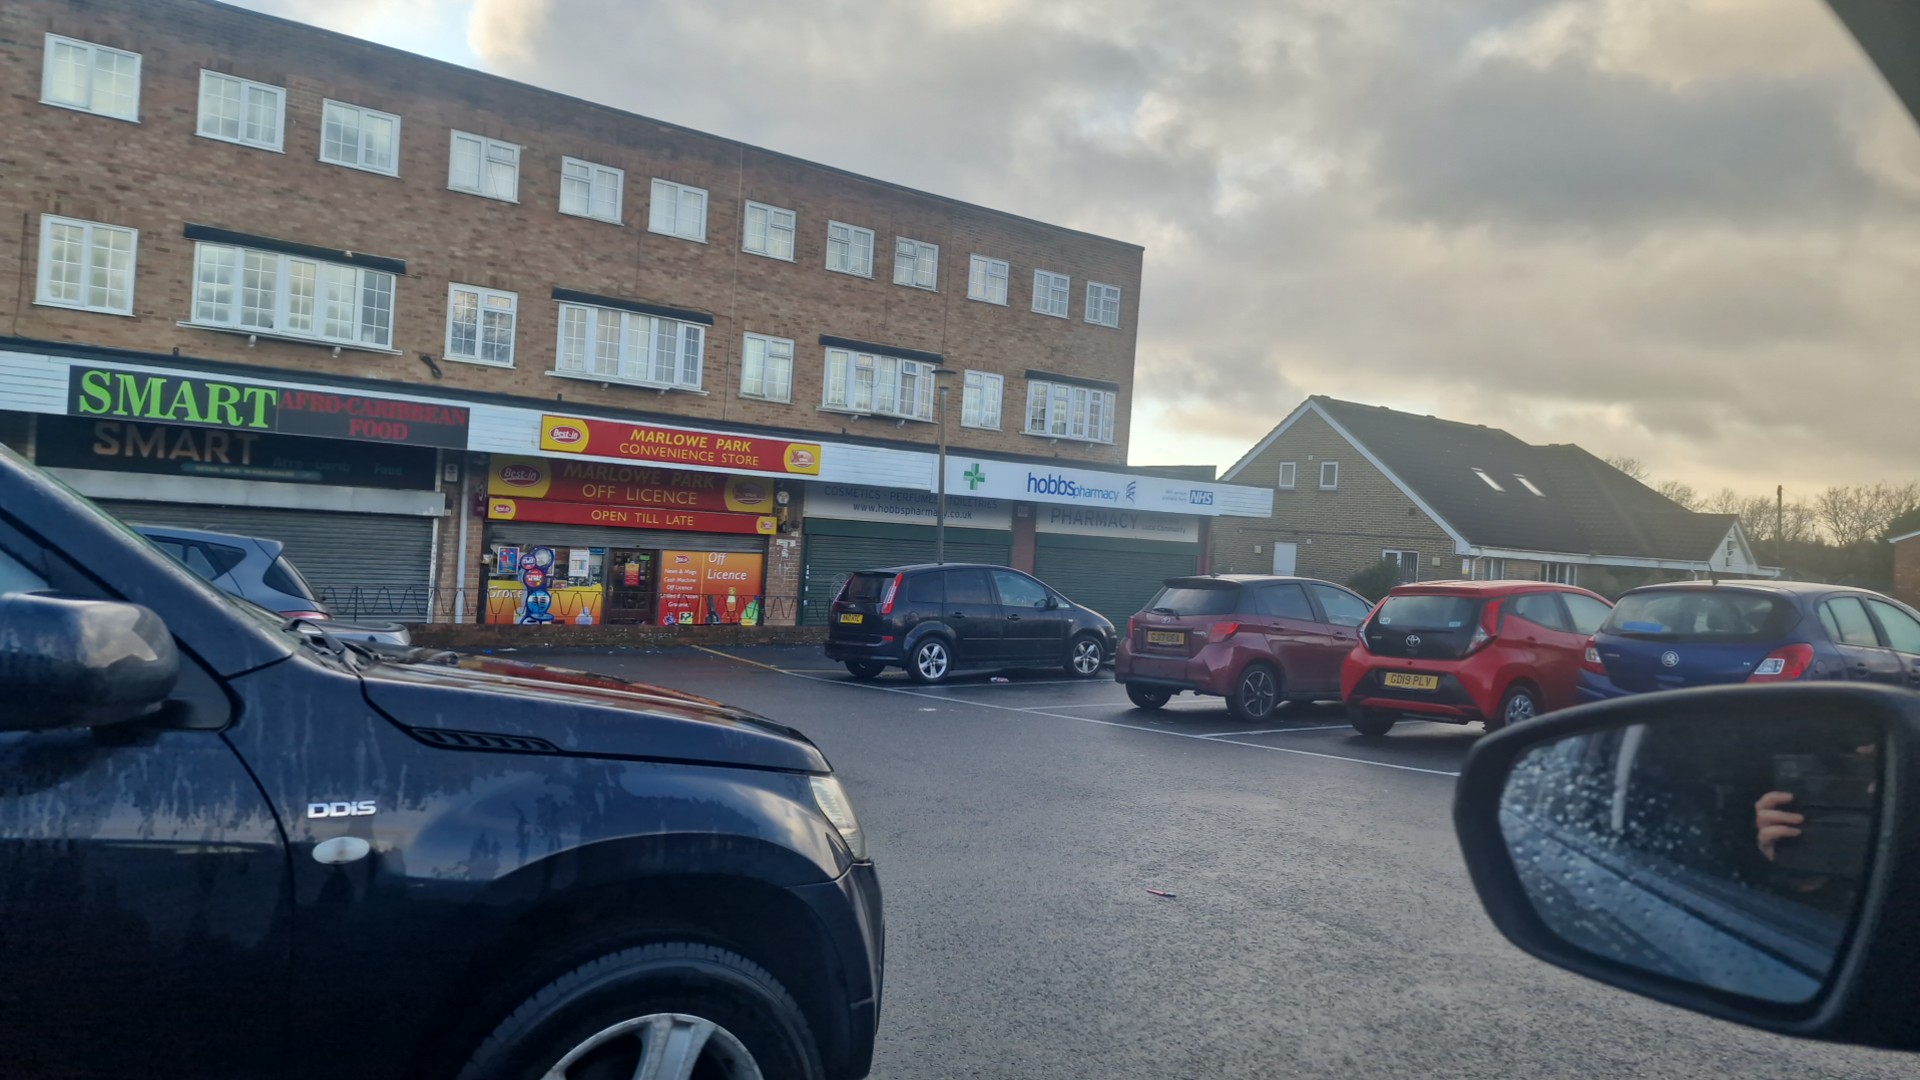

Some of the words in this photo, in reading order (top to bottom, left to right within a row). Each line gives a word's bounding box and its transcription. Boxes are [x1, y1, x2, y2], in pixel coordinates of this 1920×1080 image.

[78, 369, 277, 428] SMART
[279, 391, 466, 426] AFRO-CARIBBEAN
[349, 418, 409, 441] FOOD
[630, 429, 708, 449] MARLOWE
[715, 438, 752, 453] PARK
[92, 422, 260, 466] SMART
[619, 442, 715, 463] CONVENIENCE
[721, 452, 760, 467] STORE
[504, 468, 538, 482] Best-in
[562, 462, 662, 486] MARLOWE
[671, 471, 716, 490] PARK
[582, 483, 617, 499] OFF
[625, 487, 698, 506] LICENCE
[823, 485, 882, 500] COSMETICS
[889, 492, 939, 505] PERFUMES
[948, 495, 998, 510] TOILETRIES
[1190, 491, 1213, 504] NHS
[590, 509, 628, 523] OPEN
[634, 512, 660, 525] TILL
[665, 514, 695, 526] LATE
[852, 501, 972, 520] www.hobbspharmay.co.uk
[1050, 506, 1140, 529] PHARMACY
[708, 551, 728, 566] Off
[707, 568, 748, 581] Licence
[1390, 673, 1411, 684] GD19
[1412, 675, 1432, 687] PLV
